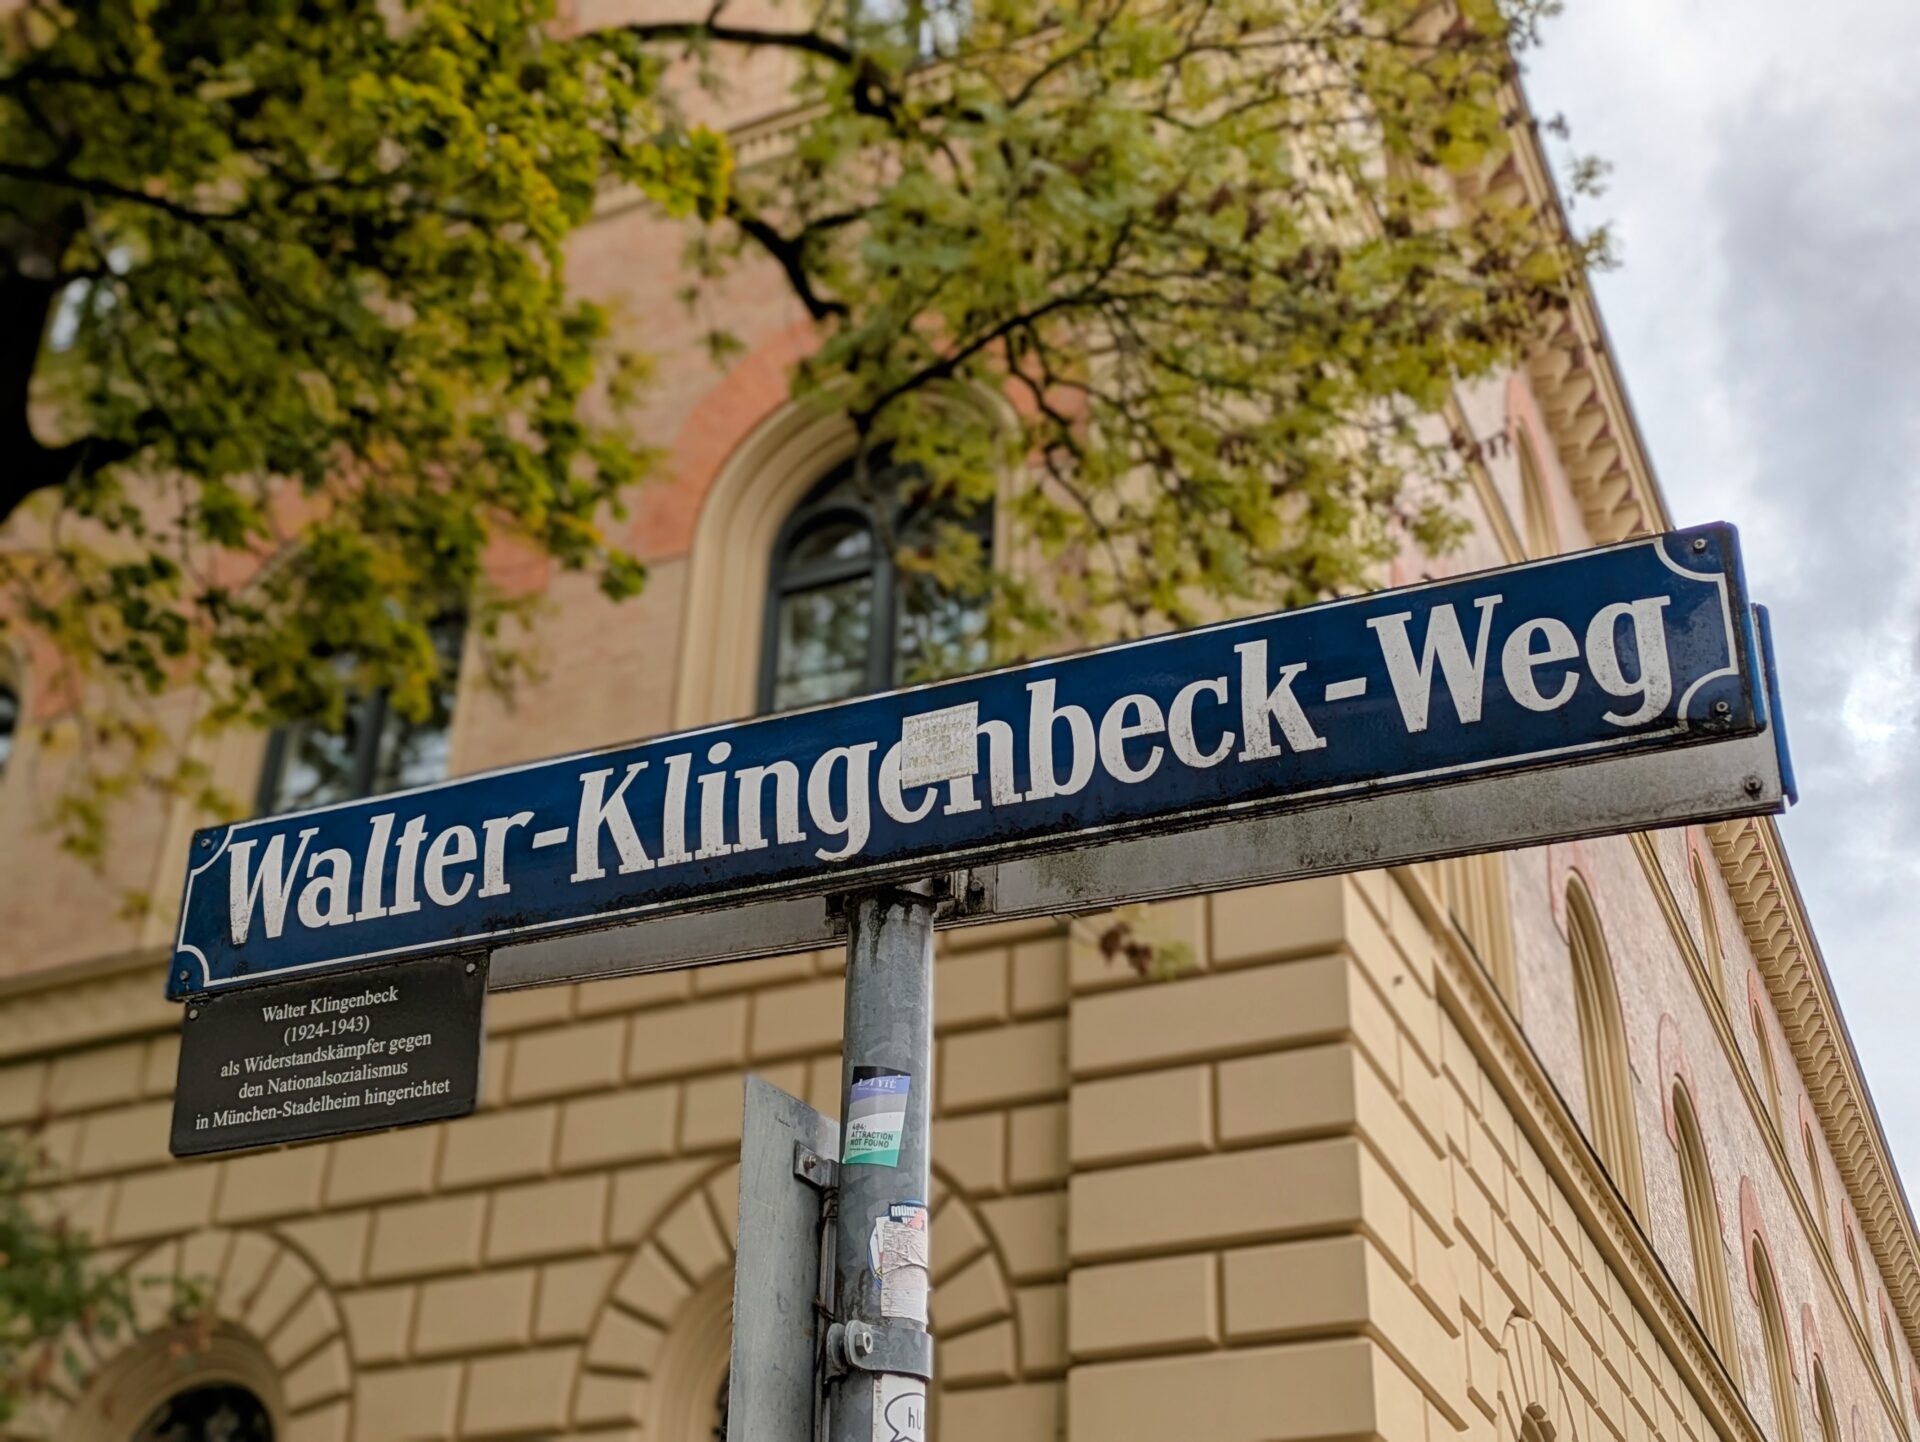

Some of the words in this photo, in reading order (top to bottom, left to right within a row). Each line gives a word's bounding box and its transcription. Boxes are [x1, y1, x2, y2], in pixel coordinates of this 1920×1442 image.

[227, 594, 1671, 946] Walter-Klingenbeck-Weg
[262, 1001, 307, 1023] Walter
[310, 985, 399, 1015] Klingenbeck
[283, 1014, 371, 1047] (1924-1943)
[220, 1061, 240, 1078] als
[244, 1040, 387, 1075] Widerstandskämpfer
[389, 1032, 432, 1055] gegen
[238, 1082, 264, 1100] den
[267, 1061, 409, 1096] Nationalsozialismus
[195, 1113, 210, 1130] in
[213, 1093, 360, 1128] München-Stadelheim
[364, 1078, 450, 1108] hingerichtet
[849, 1138, 863, 1147] NOT
[863, 1138, 890, 1149] FOUND
[851, 1130, 894, 1142] ATTRACTION
